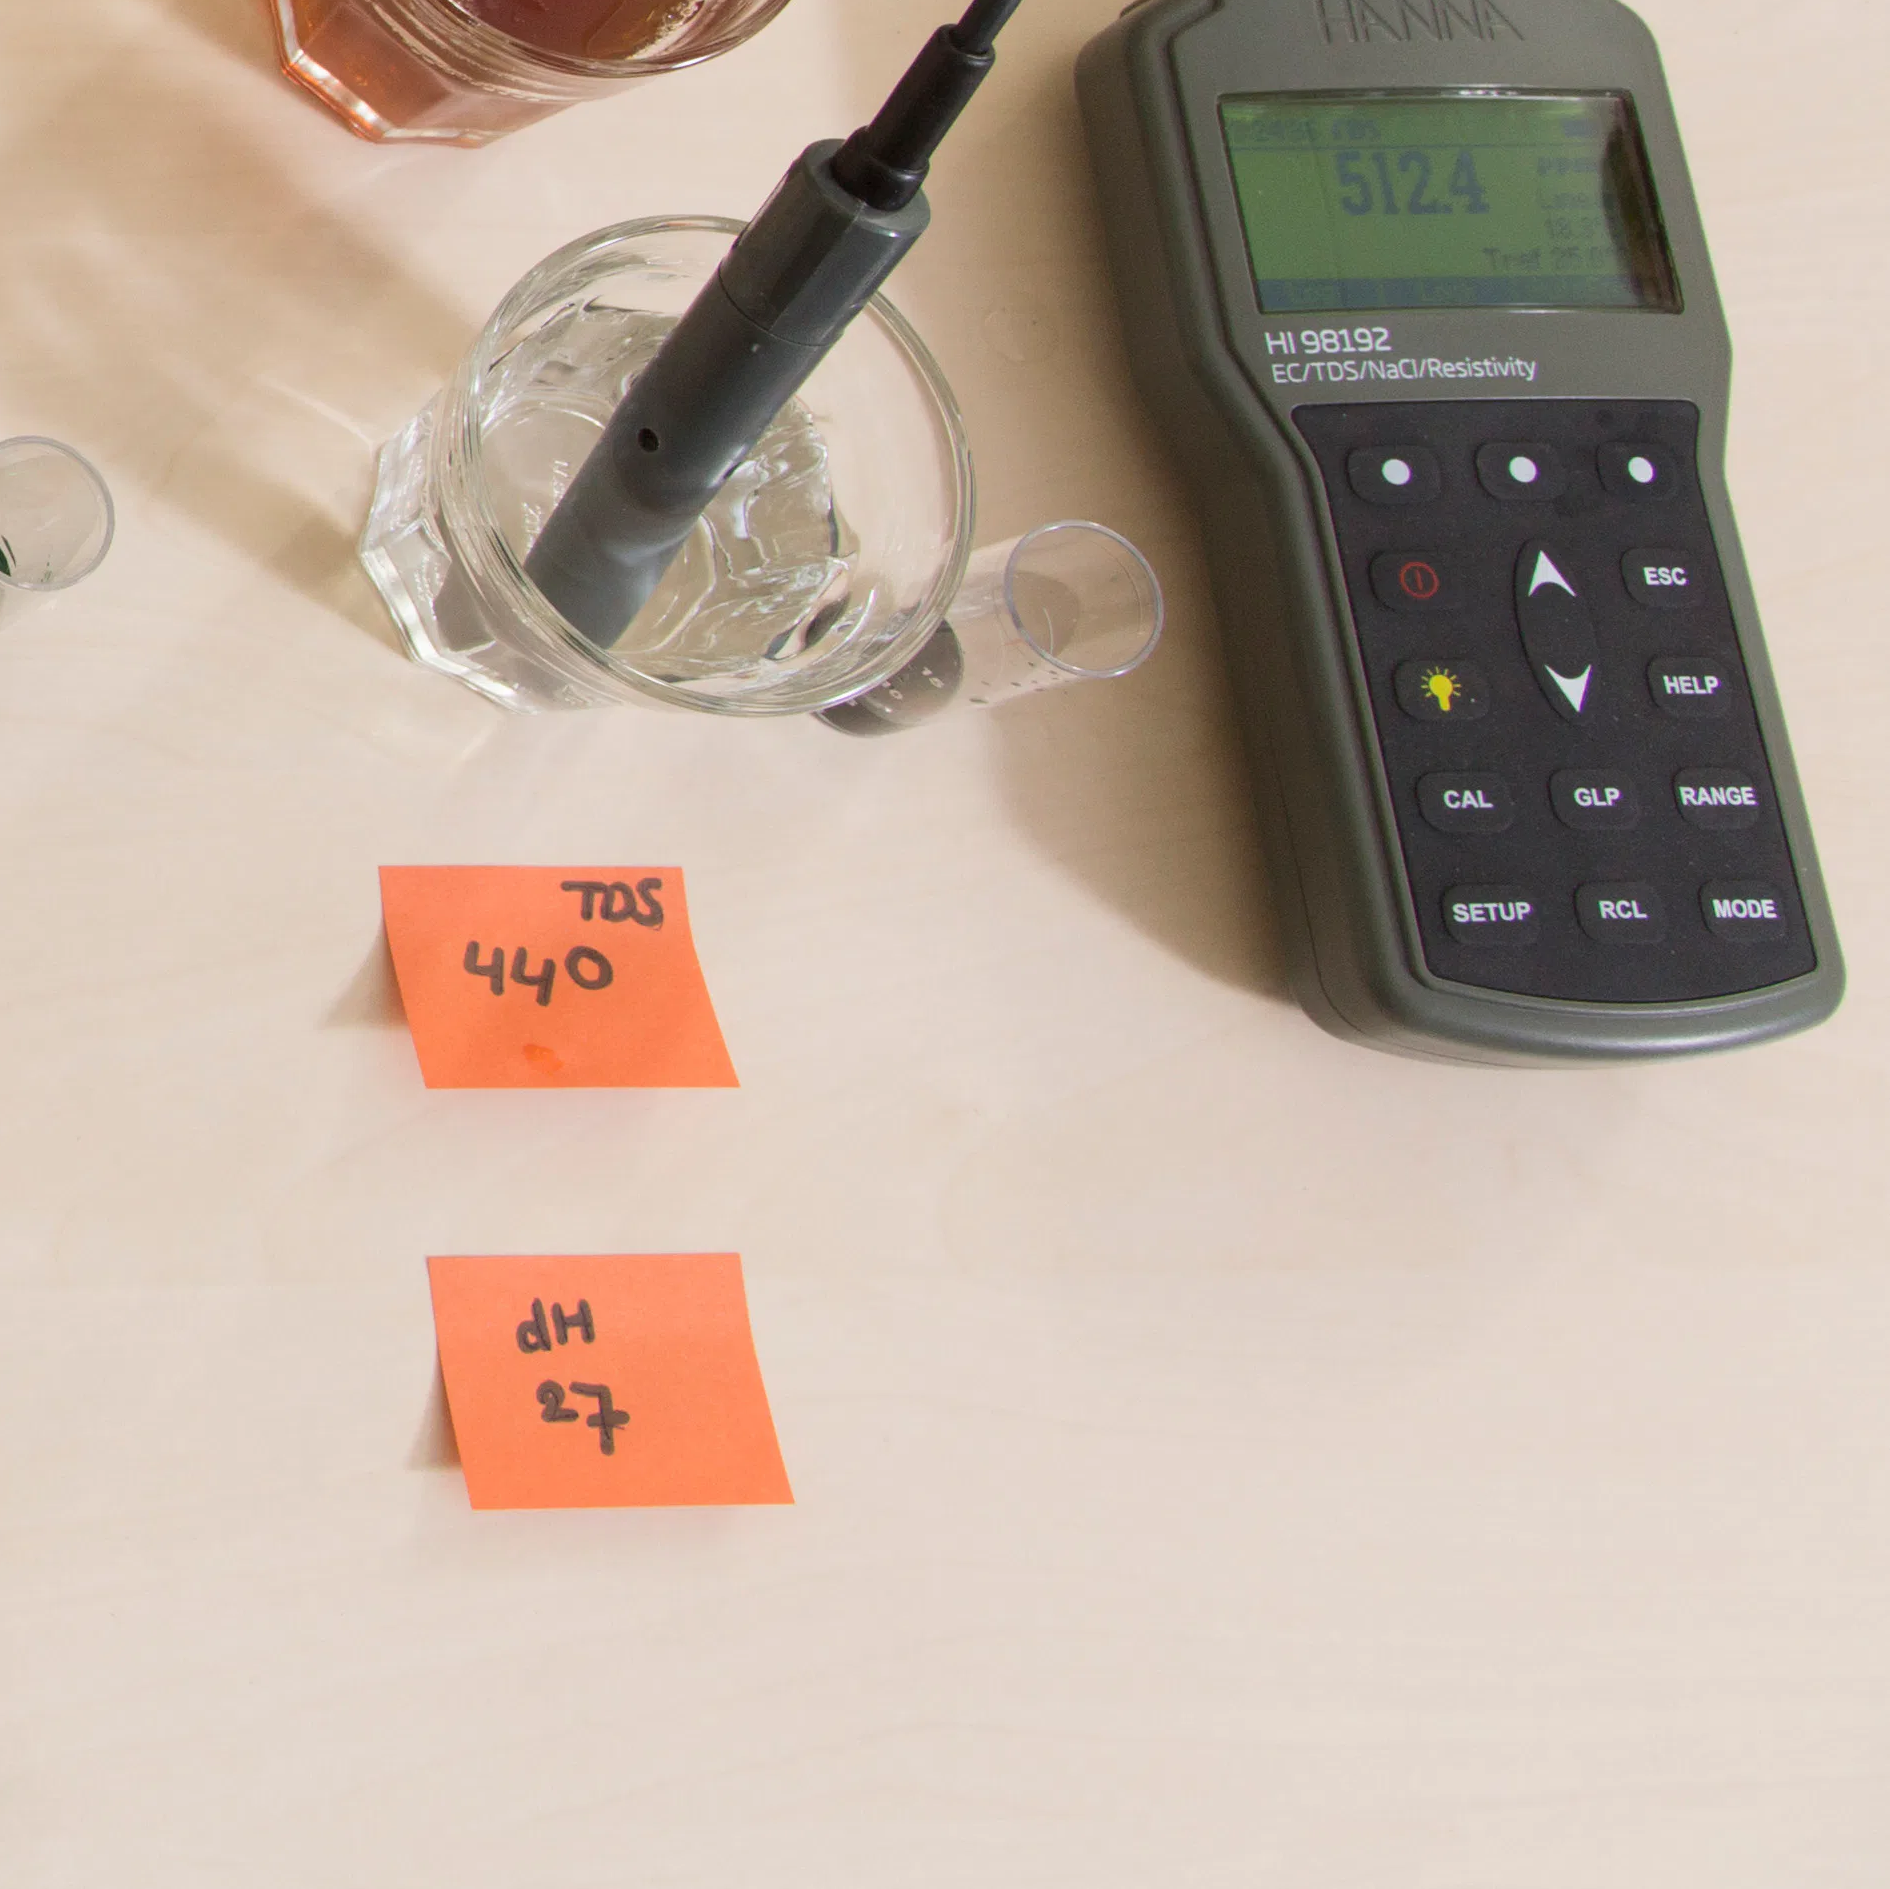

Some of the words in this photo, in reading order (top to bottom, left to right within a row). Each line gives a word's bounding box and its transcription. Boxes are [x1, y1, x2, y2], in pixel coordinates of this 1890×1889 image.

[1334, 148, 1489, 215] 512.4
[1264, 330, 1297, 355] HI
[1300, 326, 1392, 355] 98192
[1271, 355, 1537, 384] EC/TDS/NaCl/Resistivity
[1642, 566, 1687, 586] ESC
[1662, 674, 1720, 695] HELP
[1443, 789, 1494, 810] CAL
[1573, 786, 1621, 807] GLP
[1679, 785, 1757, 806] RANGE
[560, 877, 665, 928] TDS
[1452, 901, 1532, 923] SETUP
[1598, 899, 1648, 920] RCL
[1712, 898, 1778, 919] MODE
[463, 940, 614, 1008] 440
[516, 1298, 596, 1354] dH
[536, 1379, 631, 1456] 27
